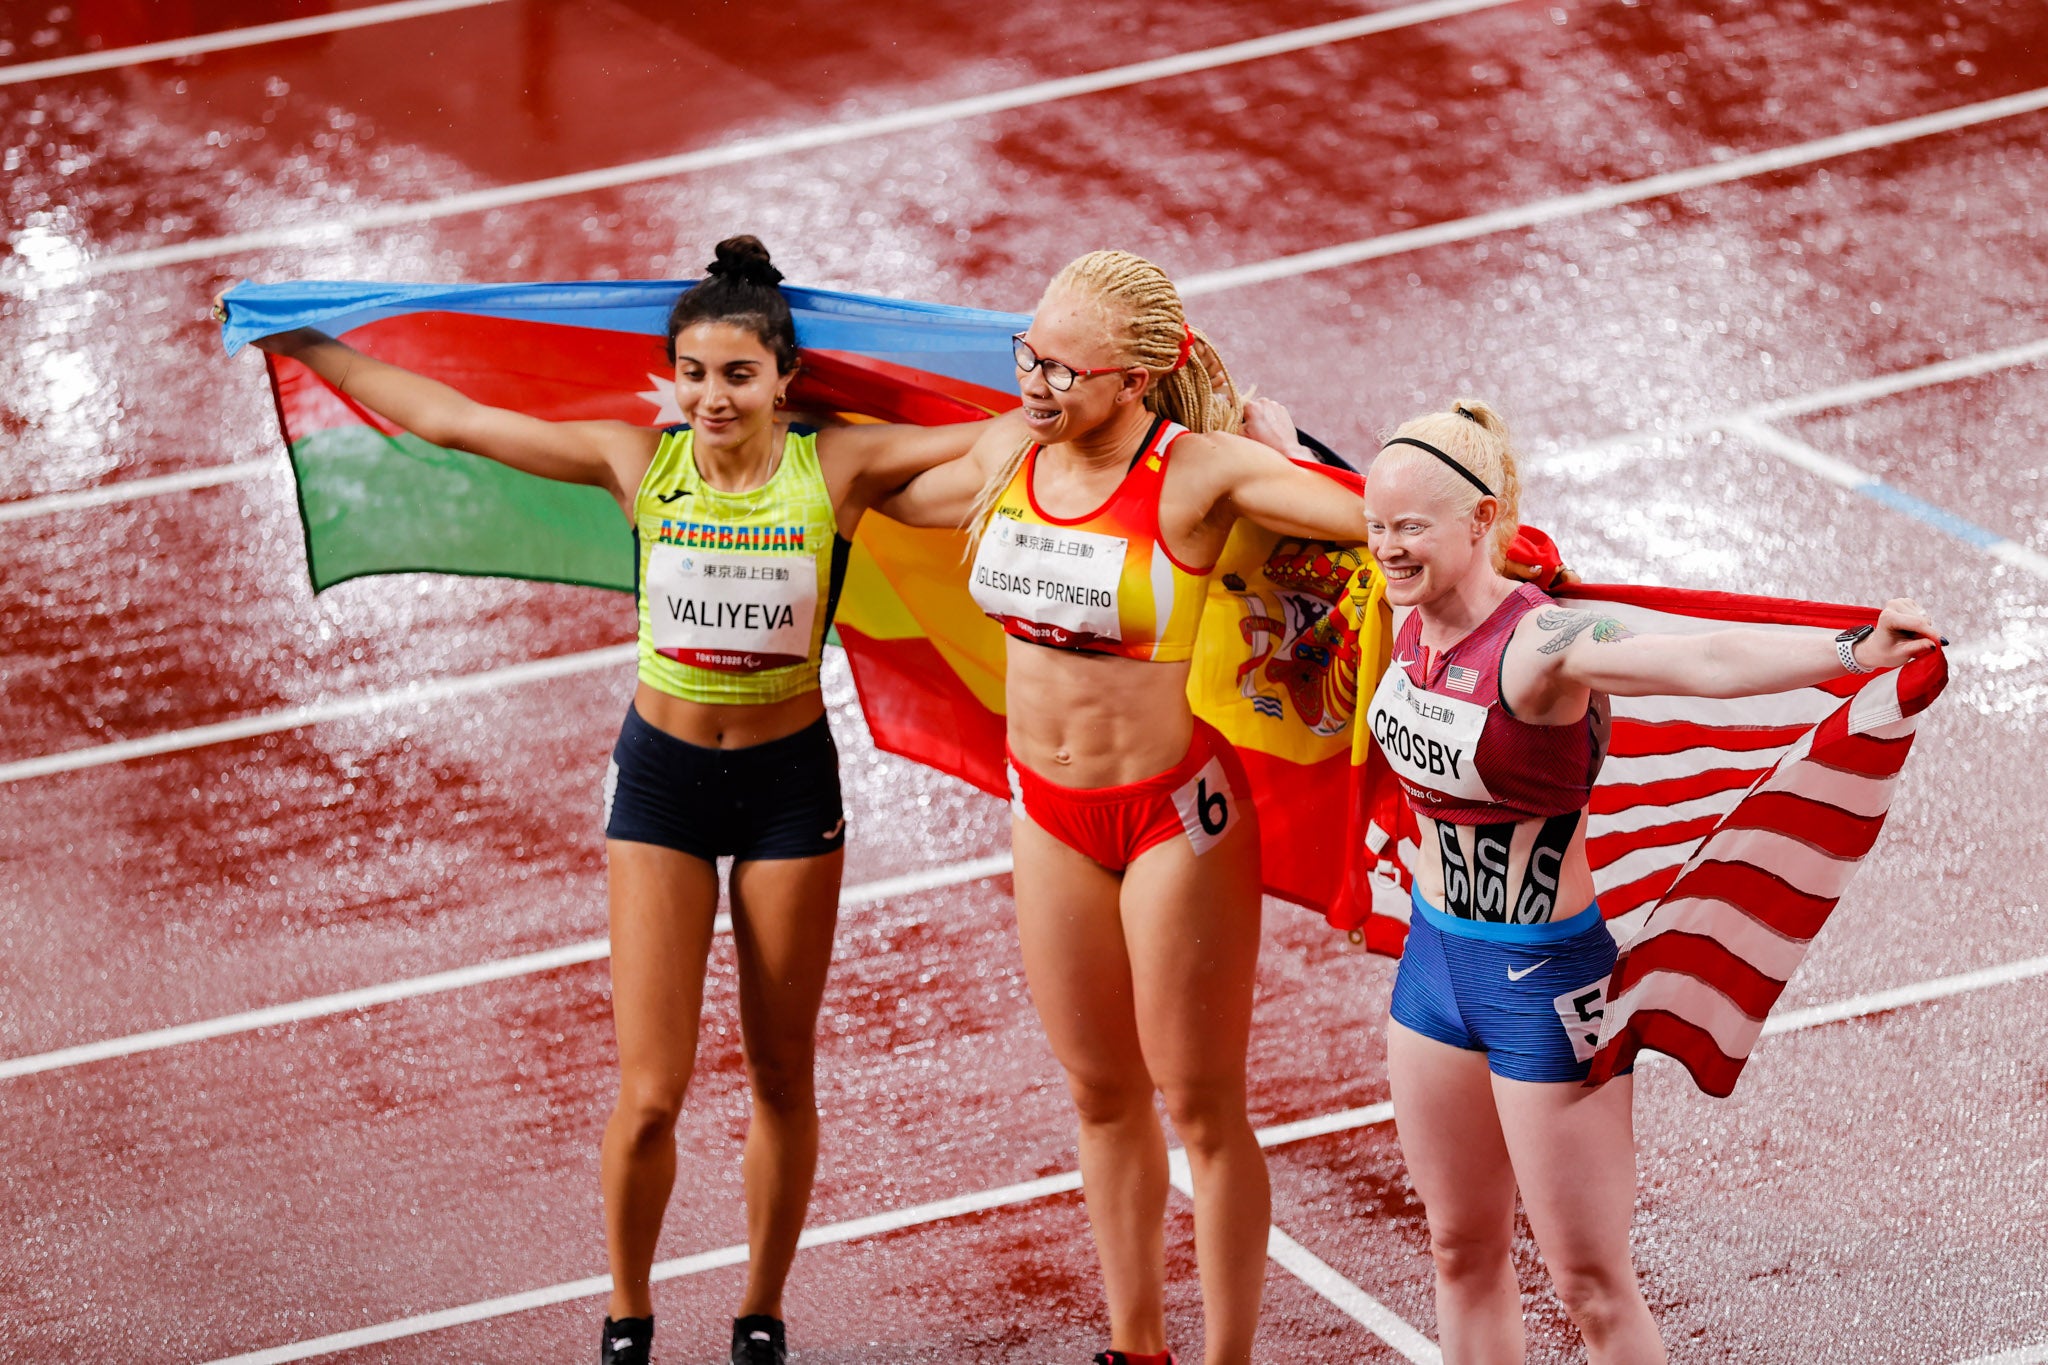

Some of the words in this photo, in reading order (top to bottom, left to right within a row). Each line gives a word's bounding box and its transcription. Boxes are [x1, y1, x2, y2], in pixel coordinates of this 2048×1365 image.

[659, 519, 805, 551] AZERBAIJAN
[1015, 533, 1095, 559] 東京海上日動
[703, 563, 790, 581] 東京海上日動
[975, 564, 1032, 596] IGLESIAS
[1036, 579, 1112, 608] FORNEIRO
[667, 595, 794, 630] VALIYEVA
[695, 652, 721, 664] TOKYO
[721, 655, 742, 666] 2020
[1374, 708, 1462, 780] CROSBY
[1197, 777, 1228, 836] 6
[1476, 837, 1507, 922] US
[1572, 988, 1604, 1047] 5
